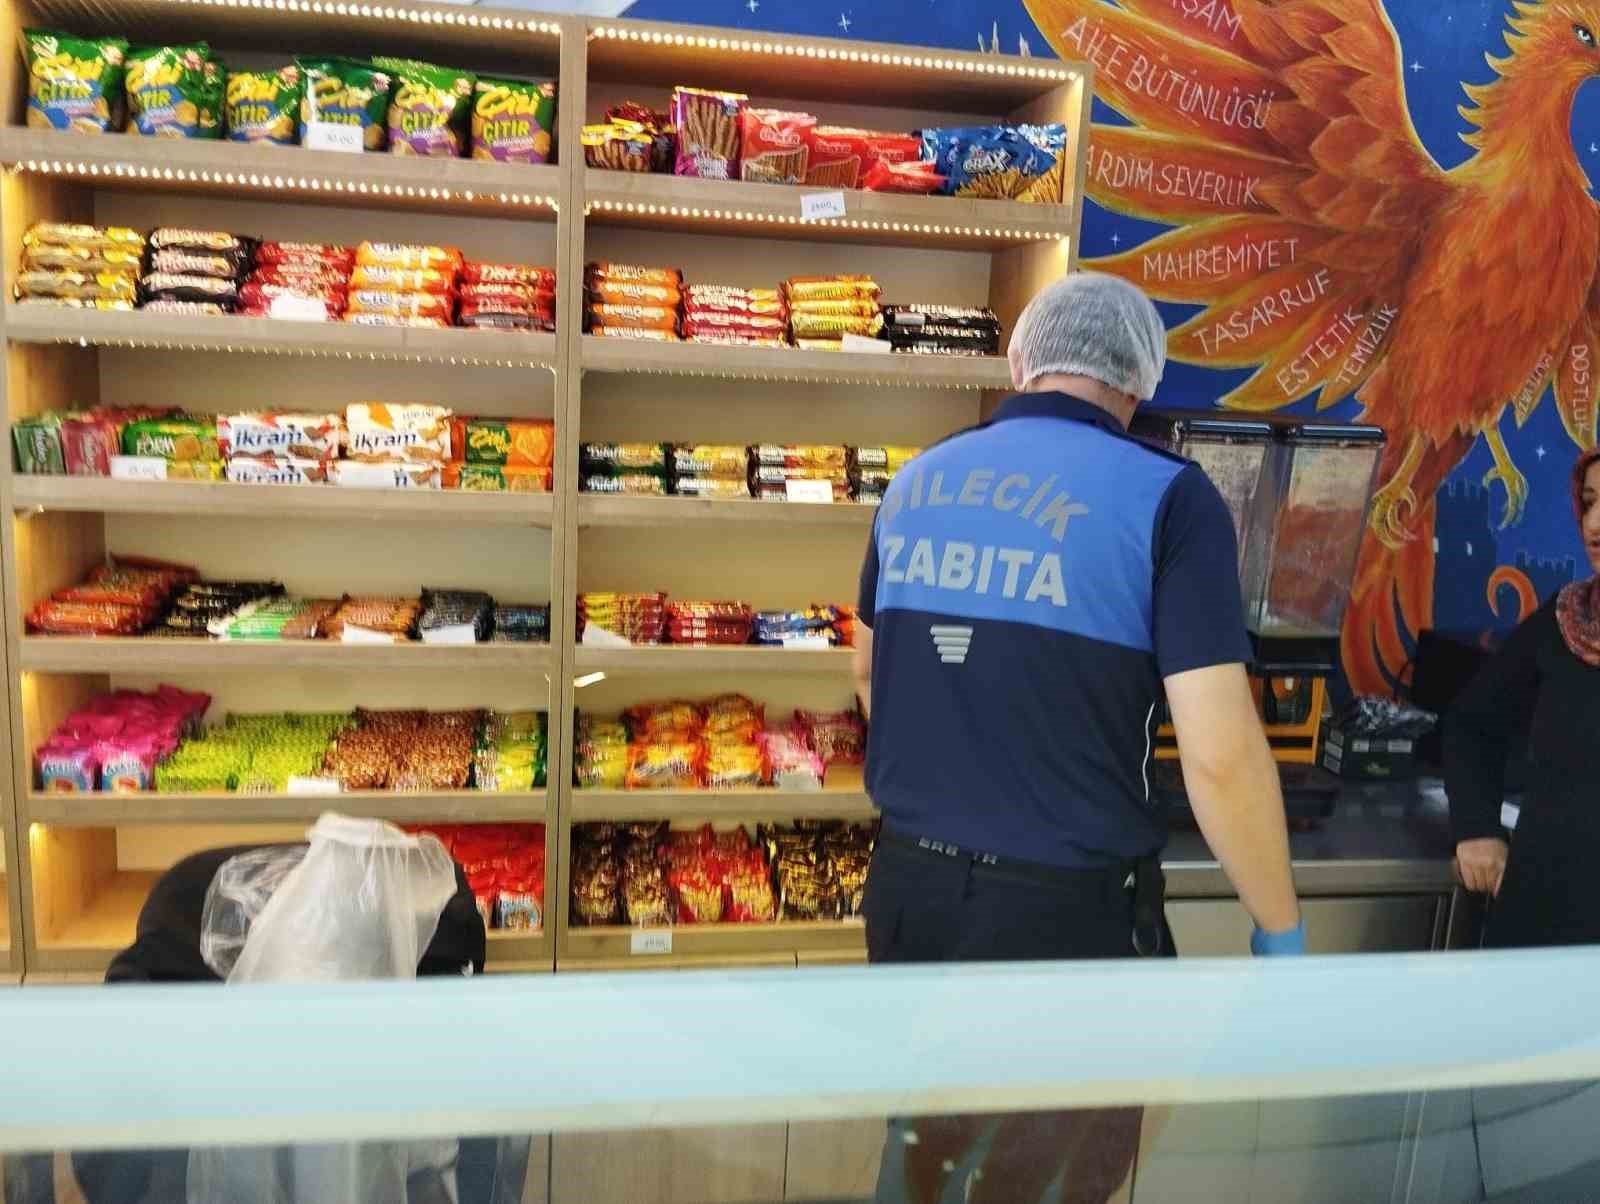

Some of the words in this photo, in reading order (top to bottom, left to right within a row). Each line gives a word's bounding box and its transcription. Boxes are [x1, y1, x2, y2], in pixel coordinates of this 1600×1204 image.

[1143, 234, 1298, 281] MAHREMİYET
[1192, 268, 1332, 355] TASARRUF
[1276, 304, 1364, 396] ESTETİK
[1571, 344, 1592, 433] DOSTLUK
[882, 535, 1068, 607] ZABITA
